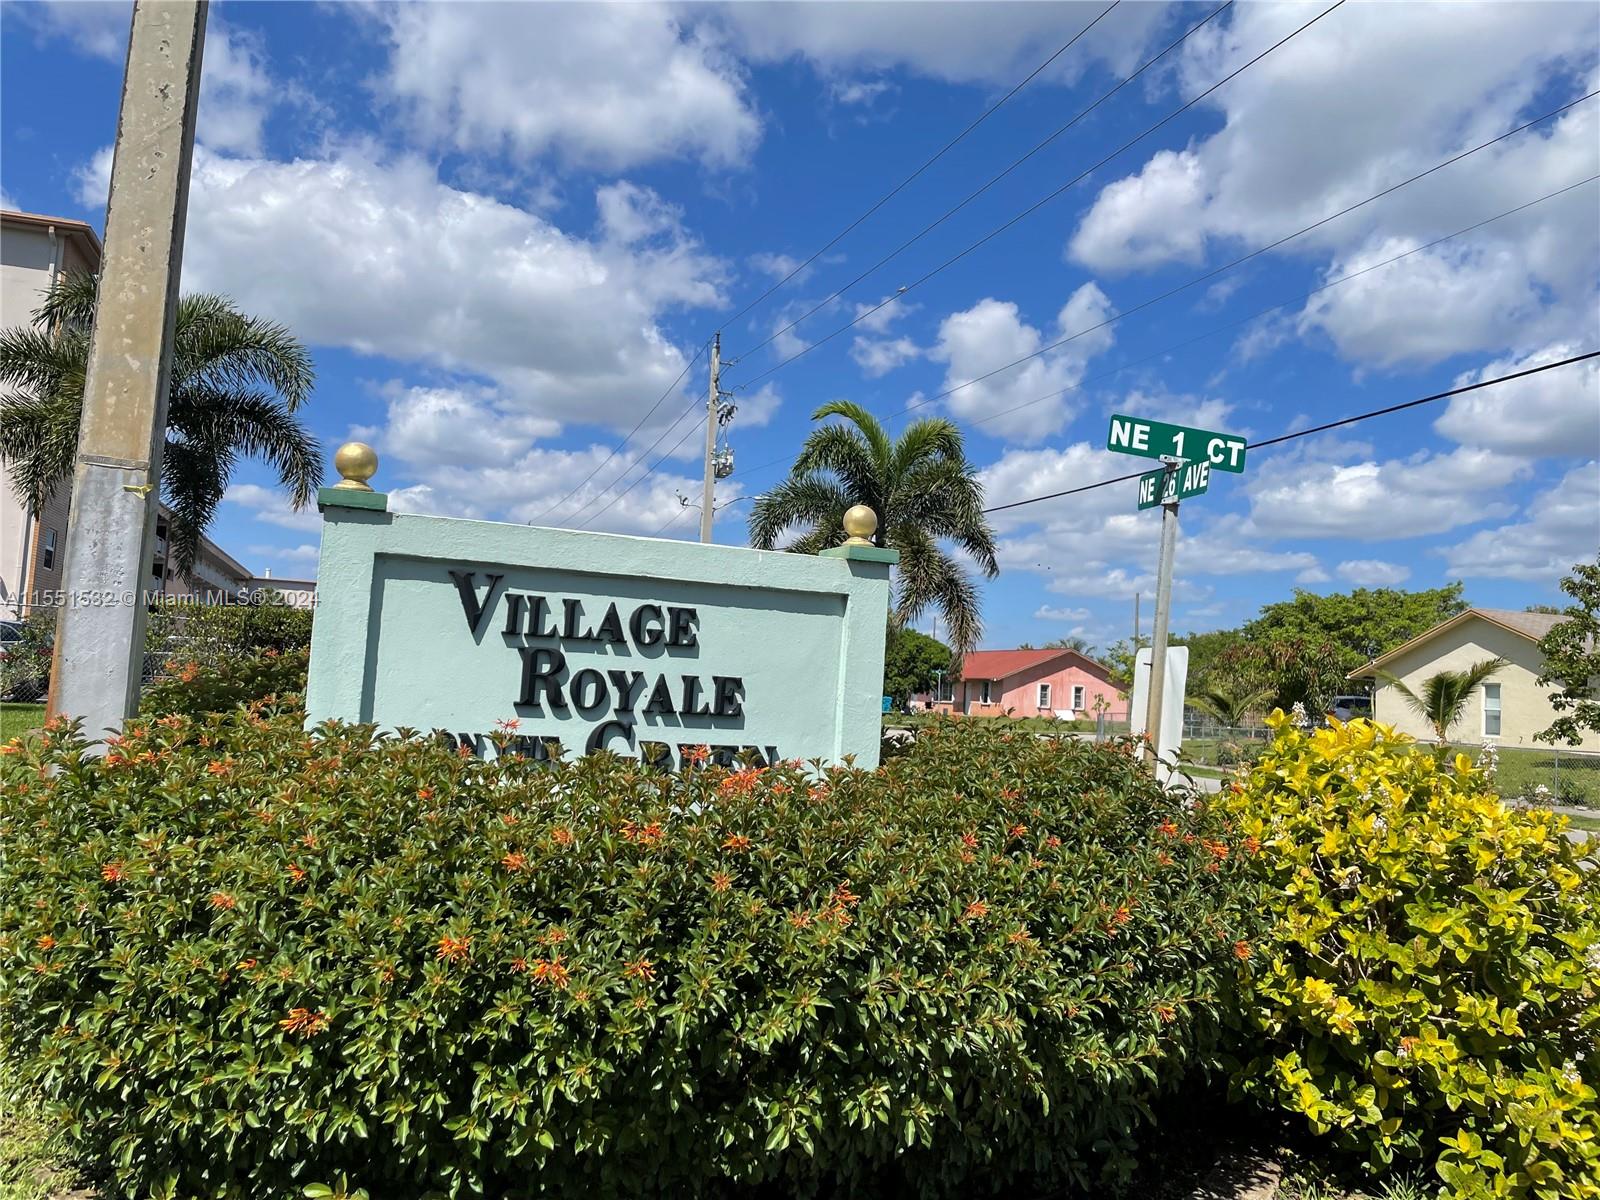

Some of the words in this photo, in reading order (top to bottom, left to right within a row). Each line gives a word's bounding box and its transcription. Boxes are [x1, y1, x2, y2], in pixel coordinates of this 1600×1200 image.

[1109, 419, 1151, 451] NE
[1172, 431, 1185, 457] 1
[1207, 438, 1245, 467] CT
[1139, 477, 1156, 505] NE
[1162, 471, 1177, 498] 26
[1182, 460, 1210, 493] AVE
[448, 570, 699, 648] VILLAGE
[513, 647, 744, 717] ROYALE
